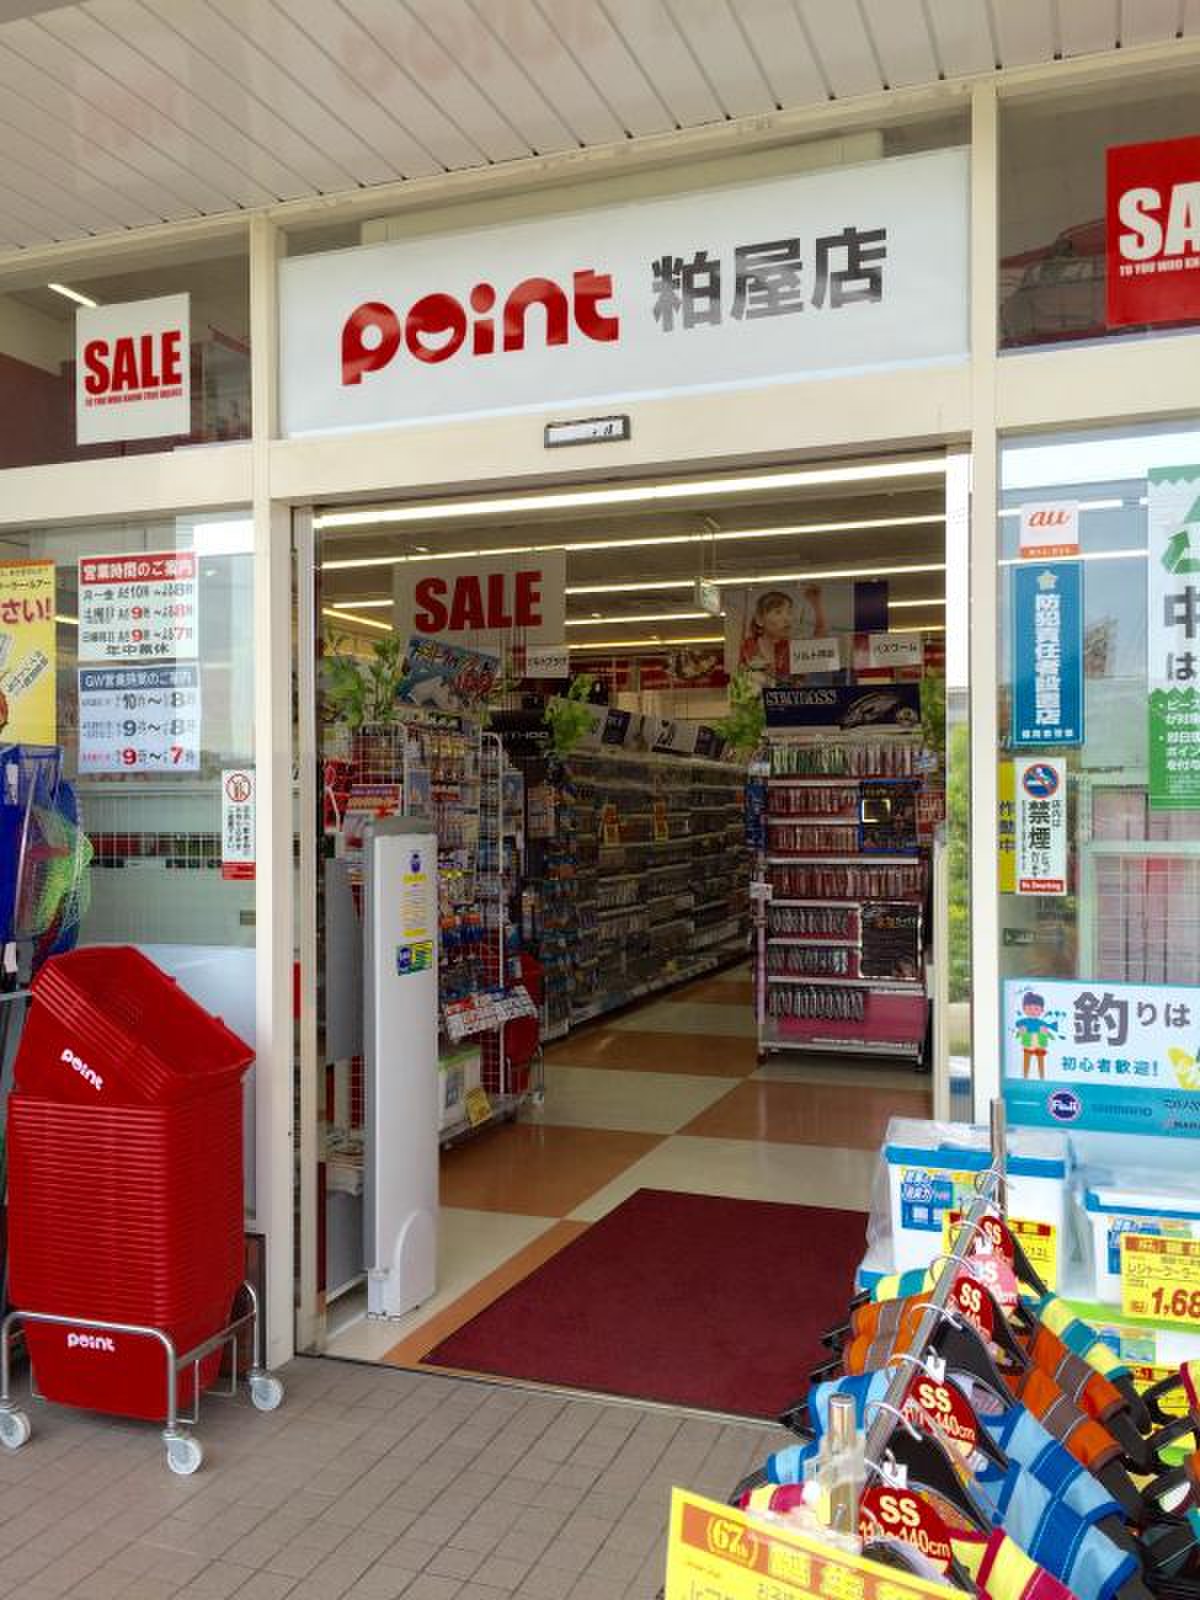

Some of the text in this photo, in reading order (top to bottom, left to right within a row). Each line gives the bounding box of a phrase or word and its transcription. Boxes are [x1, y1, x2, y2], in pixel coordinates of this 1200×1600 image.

[652, 227, 886, 333] 粕屋店
[342, 269, 619, 385] point
[84, 330, 182, 395] SALE
[1028, 509, 1071, 528] au
[415, 571, 543, 633] SALE
[1167, 651, 1198, 682] は
[1028, 801, 1051, 849] 禁煙
[1073, 992, 1191, 1046] 釣りは
[61, 1049, 103, 1091] point
[1061, 1056, 1158, 1077] 初心者歓迎!
[960, 1282, 982, 1312] SS
[67, 1333, 115, 1352] point
[919, 1383, 952, 1413] SS
[879, 1495, 920, 1527] SS
